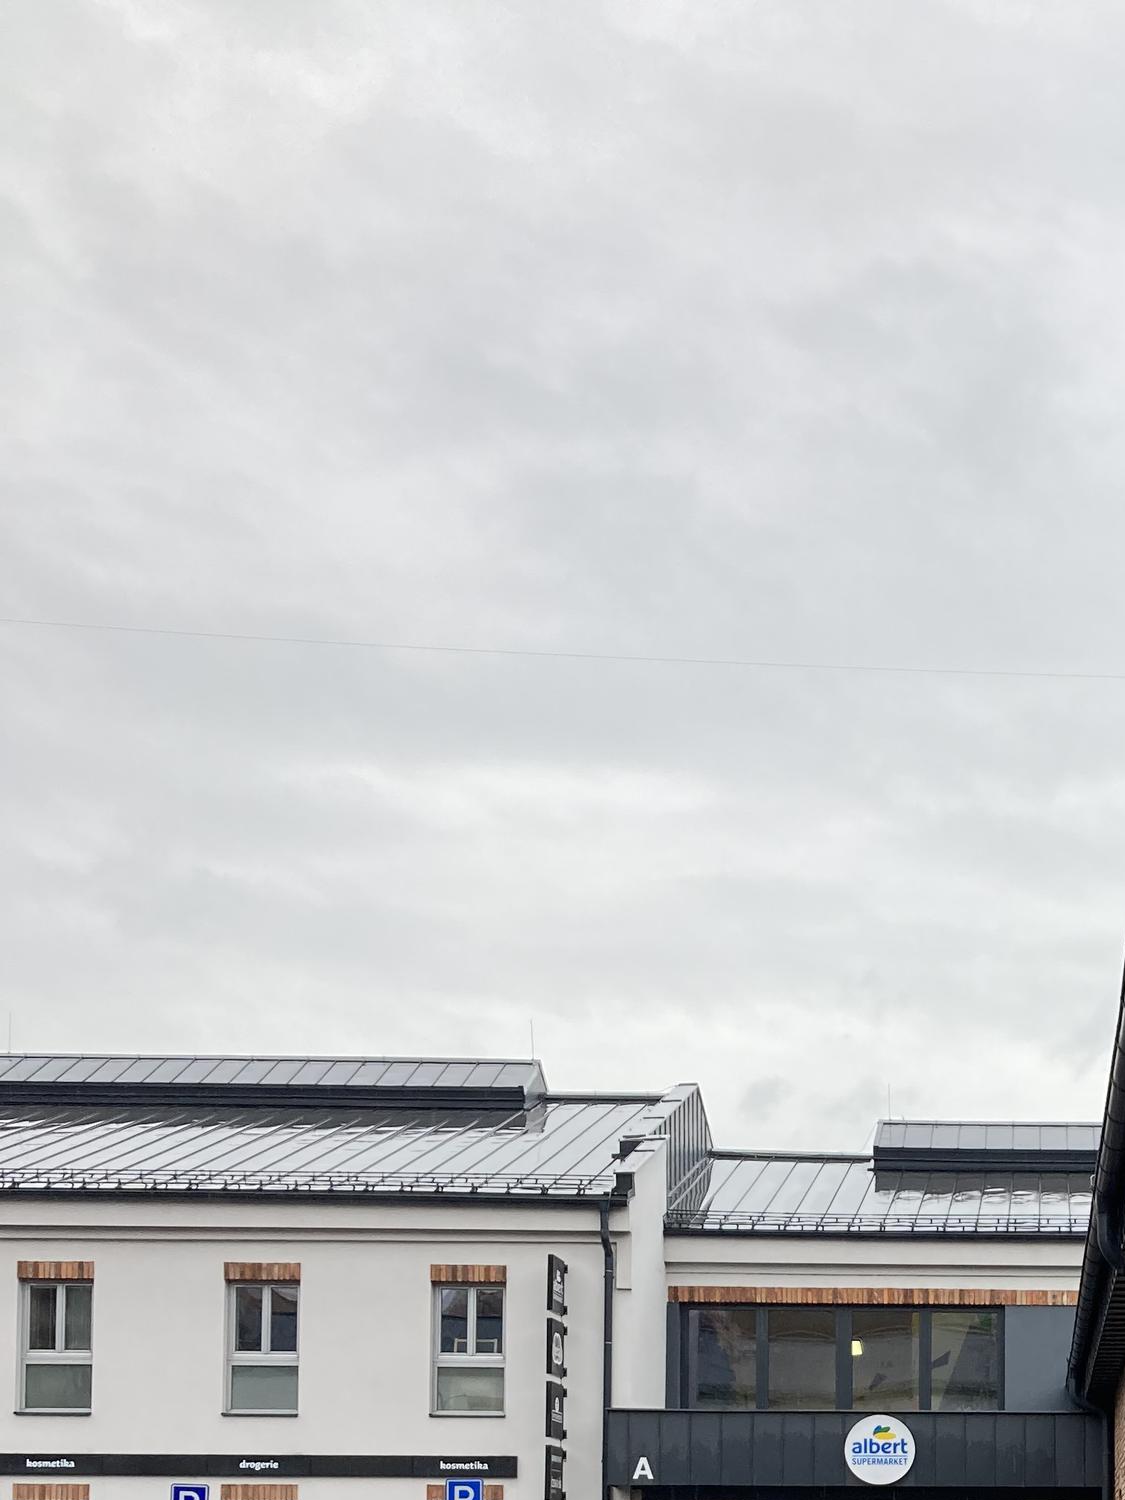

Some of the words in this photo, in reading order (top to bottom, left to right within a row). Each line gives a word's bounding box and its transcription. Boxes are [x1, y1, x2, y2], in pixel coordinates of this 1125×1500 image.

[852, 1438, 908, 1454] albert
[26, 1459, 75, 1468] kosmetika
[239, 1460, 279, 1471] drogerie
[439, 1461, 489, 1470] kosmetika
[852, 1457, 908, 1466] SUPERMARKET
[632, 1457, 654, 1479] A
